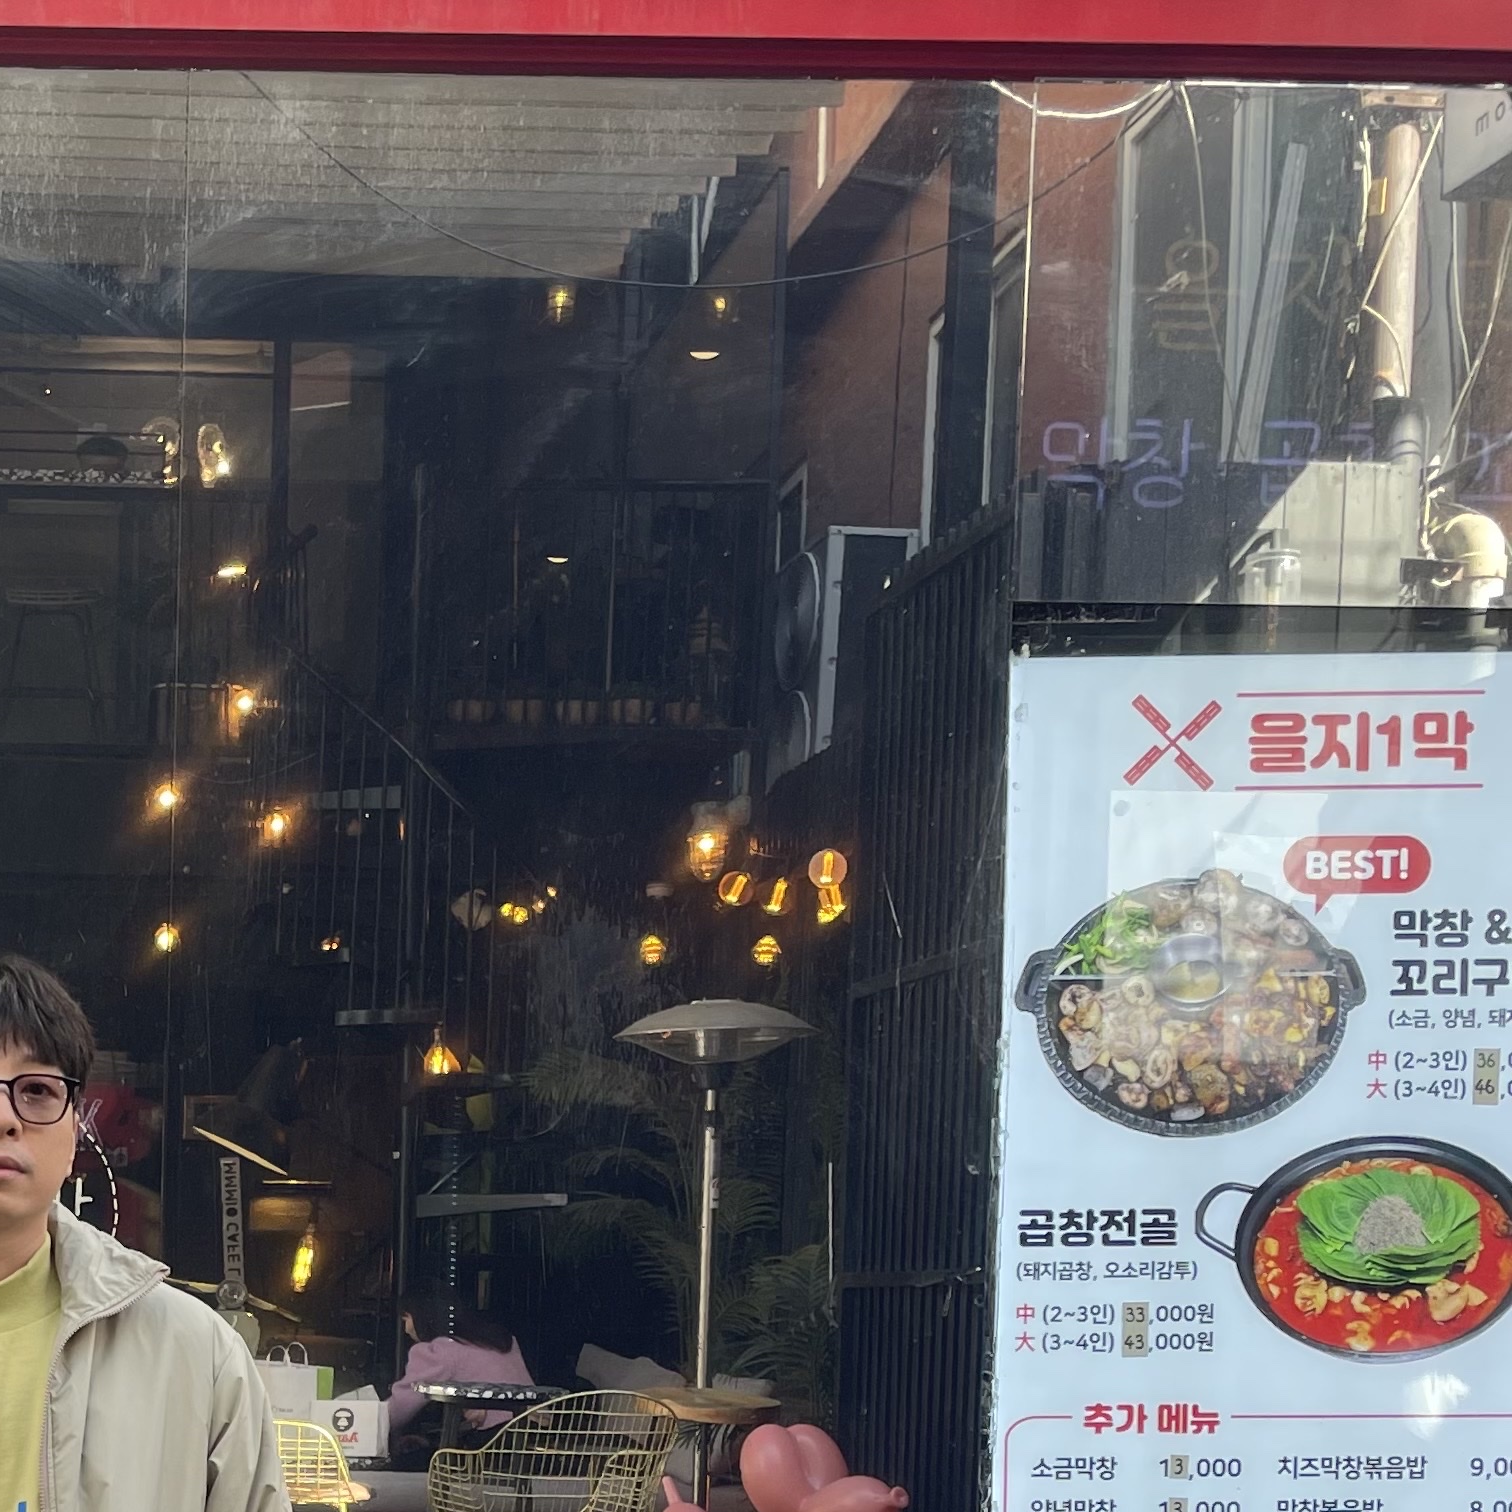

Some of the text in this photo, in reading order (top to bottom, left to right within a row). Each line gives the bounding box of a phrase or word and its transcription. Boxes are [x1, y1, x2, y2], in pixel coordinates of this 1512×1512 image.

[1247, 710, 1476, 774] 을지1막
[1305, 848, 1410, 882] BEST!
[1393, 908, 1473, 948] 막창
[1388, 1008, 1436, 1030] (소금,
[1442, 1008, 1482, 1029] 양념,
[1368, 1050, 1387, 1071] 中
[1394, 1051, 1468, 1072] (2~3인)
[1366, 1078, 1387, 1099] 大
[1394, 1078, 1467, 1100] (3~4인)
[1016, 1208, 1178, 1248] 곱창전골
[1016, 1260, 1199, 1282] (돼지곱창, 오소리감투)
[1016, 1304, 1215, 1326] 中 (2~3인) 33,000원
[1015, 1331, 1215, 1354] 大 (3~4인) 43,000원
[1083, 1403, 1221, 1435] 추가 메뉴
[1031, 1457, 1242, 1481] 소금막창 13,000
[1277, 1456, 1512, 1480] 치즈막창볶음밥 9,0
